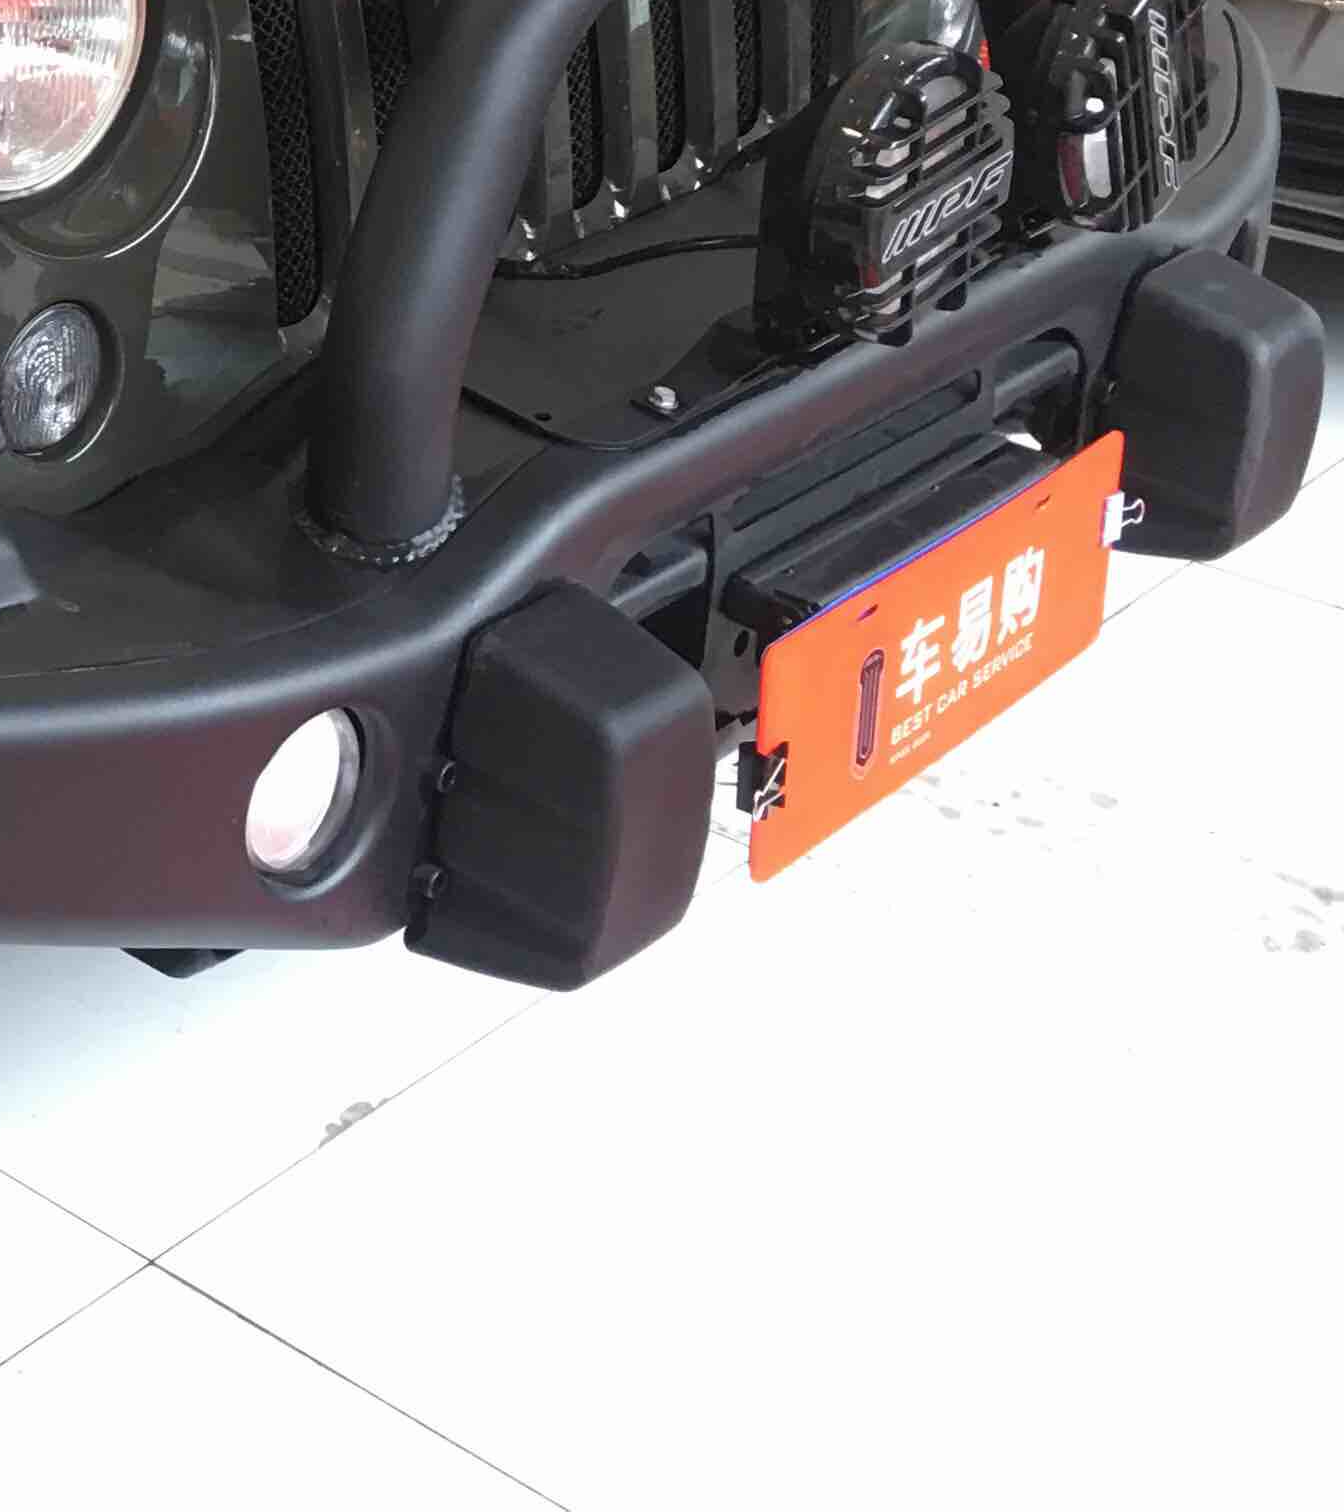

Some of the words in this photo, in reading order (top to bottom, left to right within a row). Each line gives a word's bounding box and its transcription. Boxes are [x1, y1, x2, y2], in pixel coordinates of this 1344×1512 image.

[890, 702, 933, 745] BEST
[936, 679, 968, 714] CAR
[973, 632, 1034, 689] SERVICE
[895, 545, 1045, 705] 车易购
